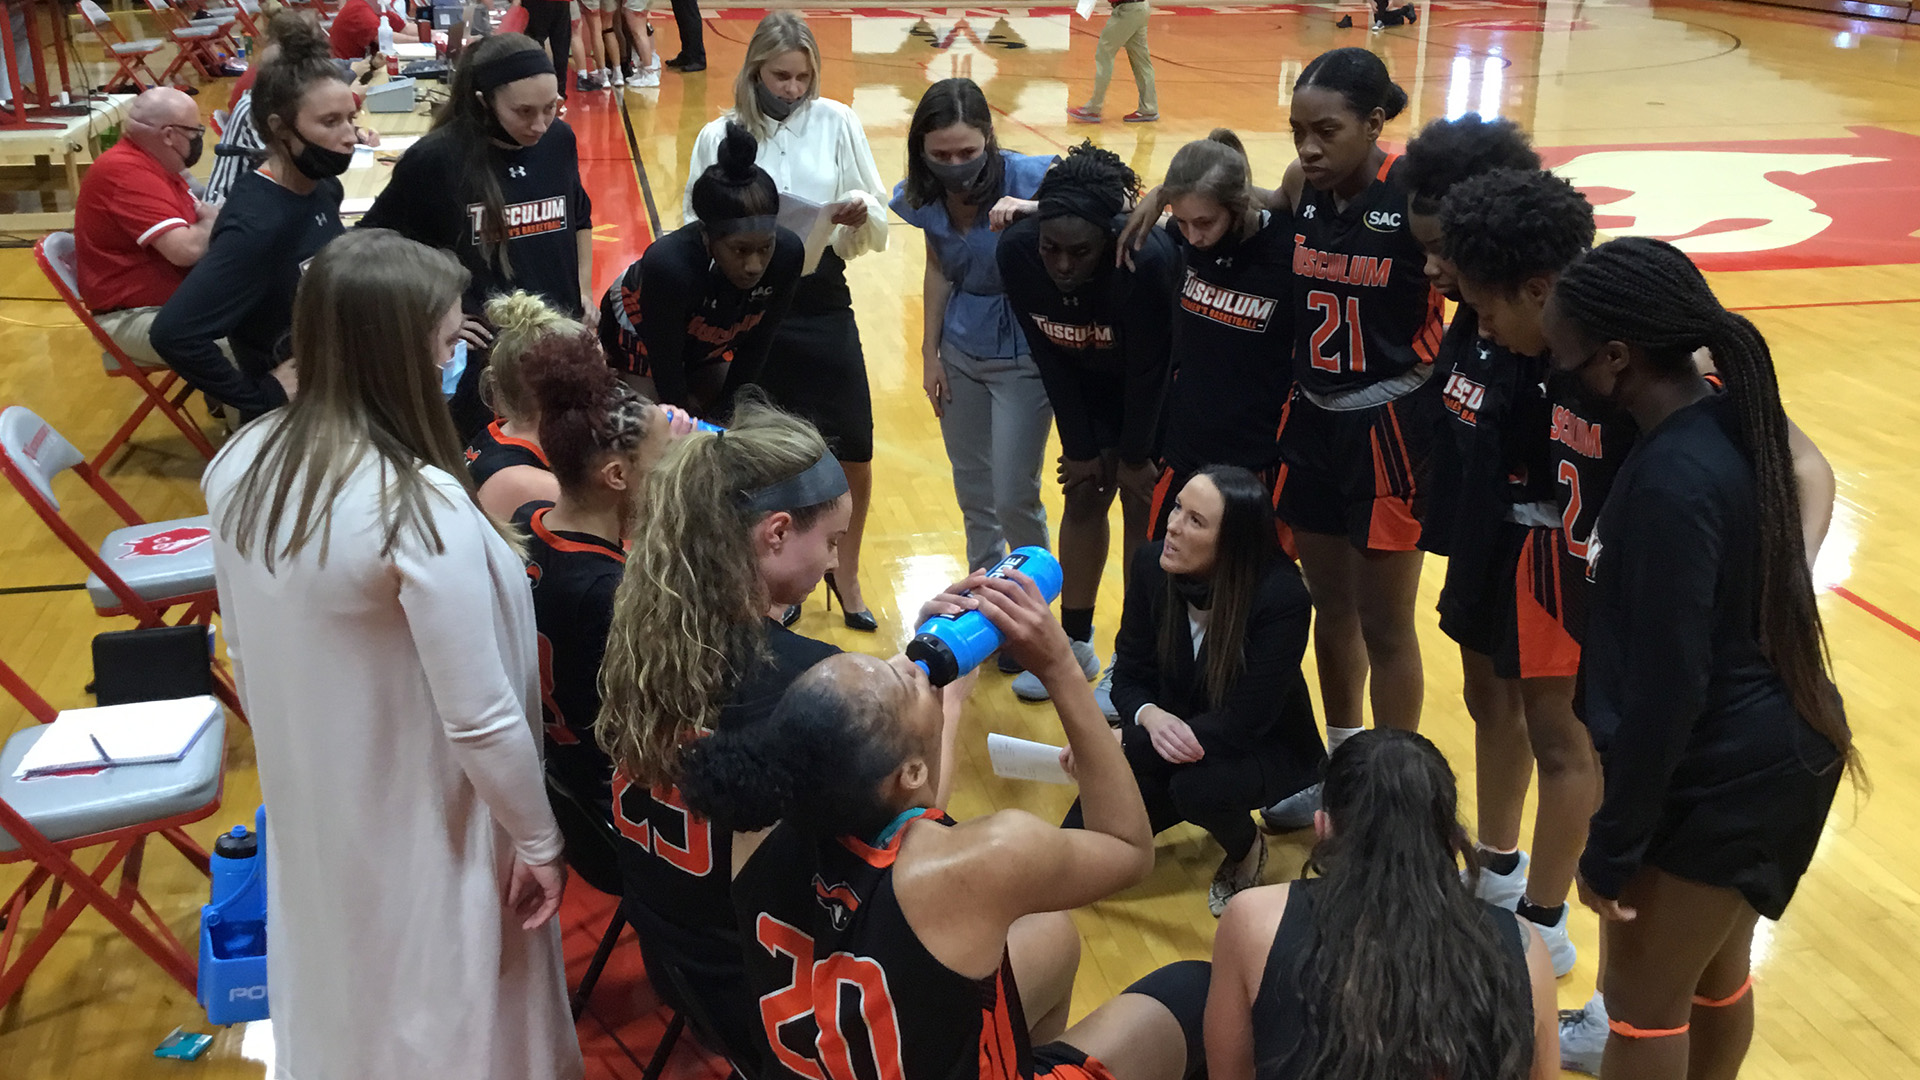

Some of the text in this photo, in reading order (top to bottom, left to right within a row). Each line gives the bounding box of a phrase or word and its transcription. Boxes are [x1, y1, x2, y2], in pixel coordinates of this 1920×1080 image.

[470, 198, 565, 231] TCULUM
[1368, 211, 1401, 227] SAC
[1292, 233, 1393, 287] TUSCULUM
[1181, 268, 1274, 320] TUSCULUM
[1307, 290, 1366, 373] 21
[756, 911, 906, 1080] 20
